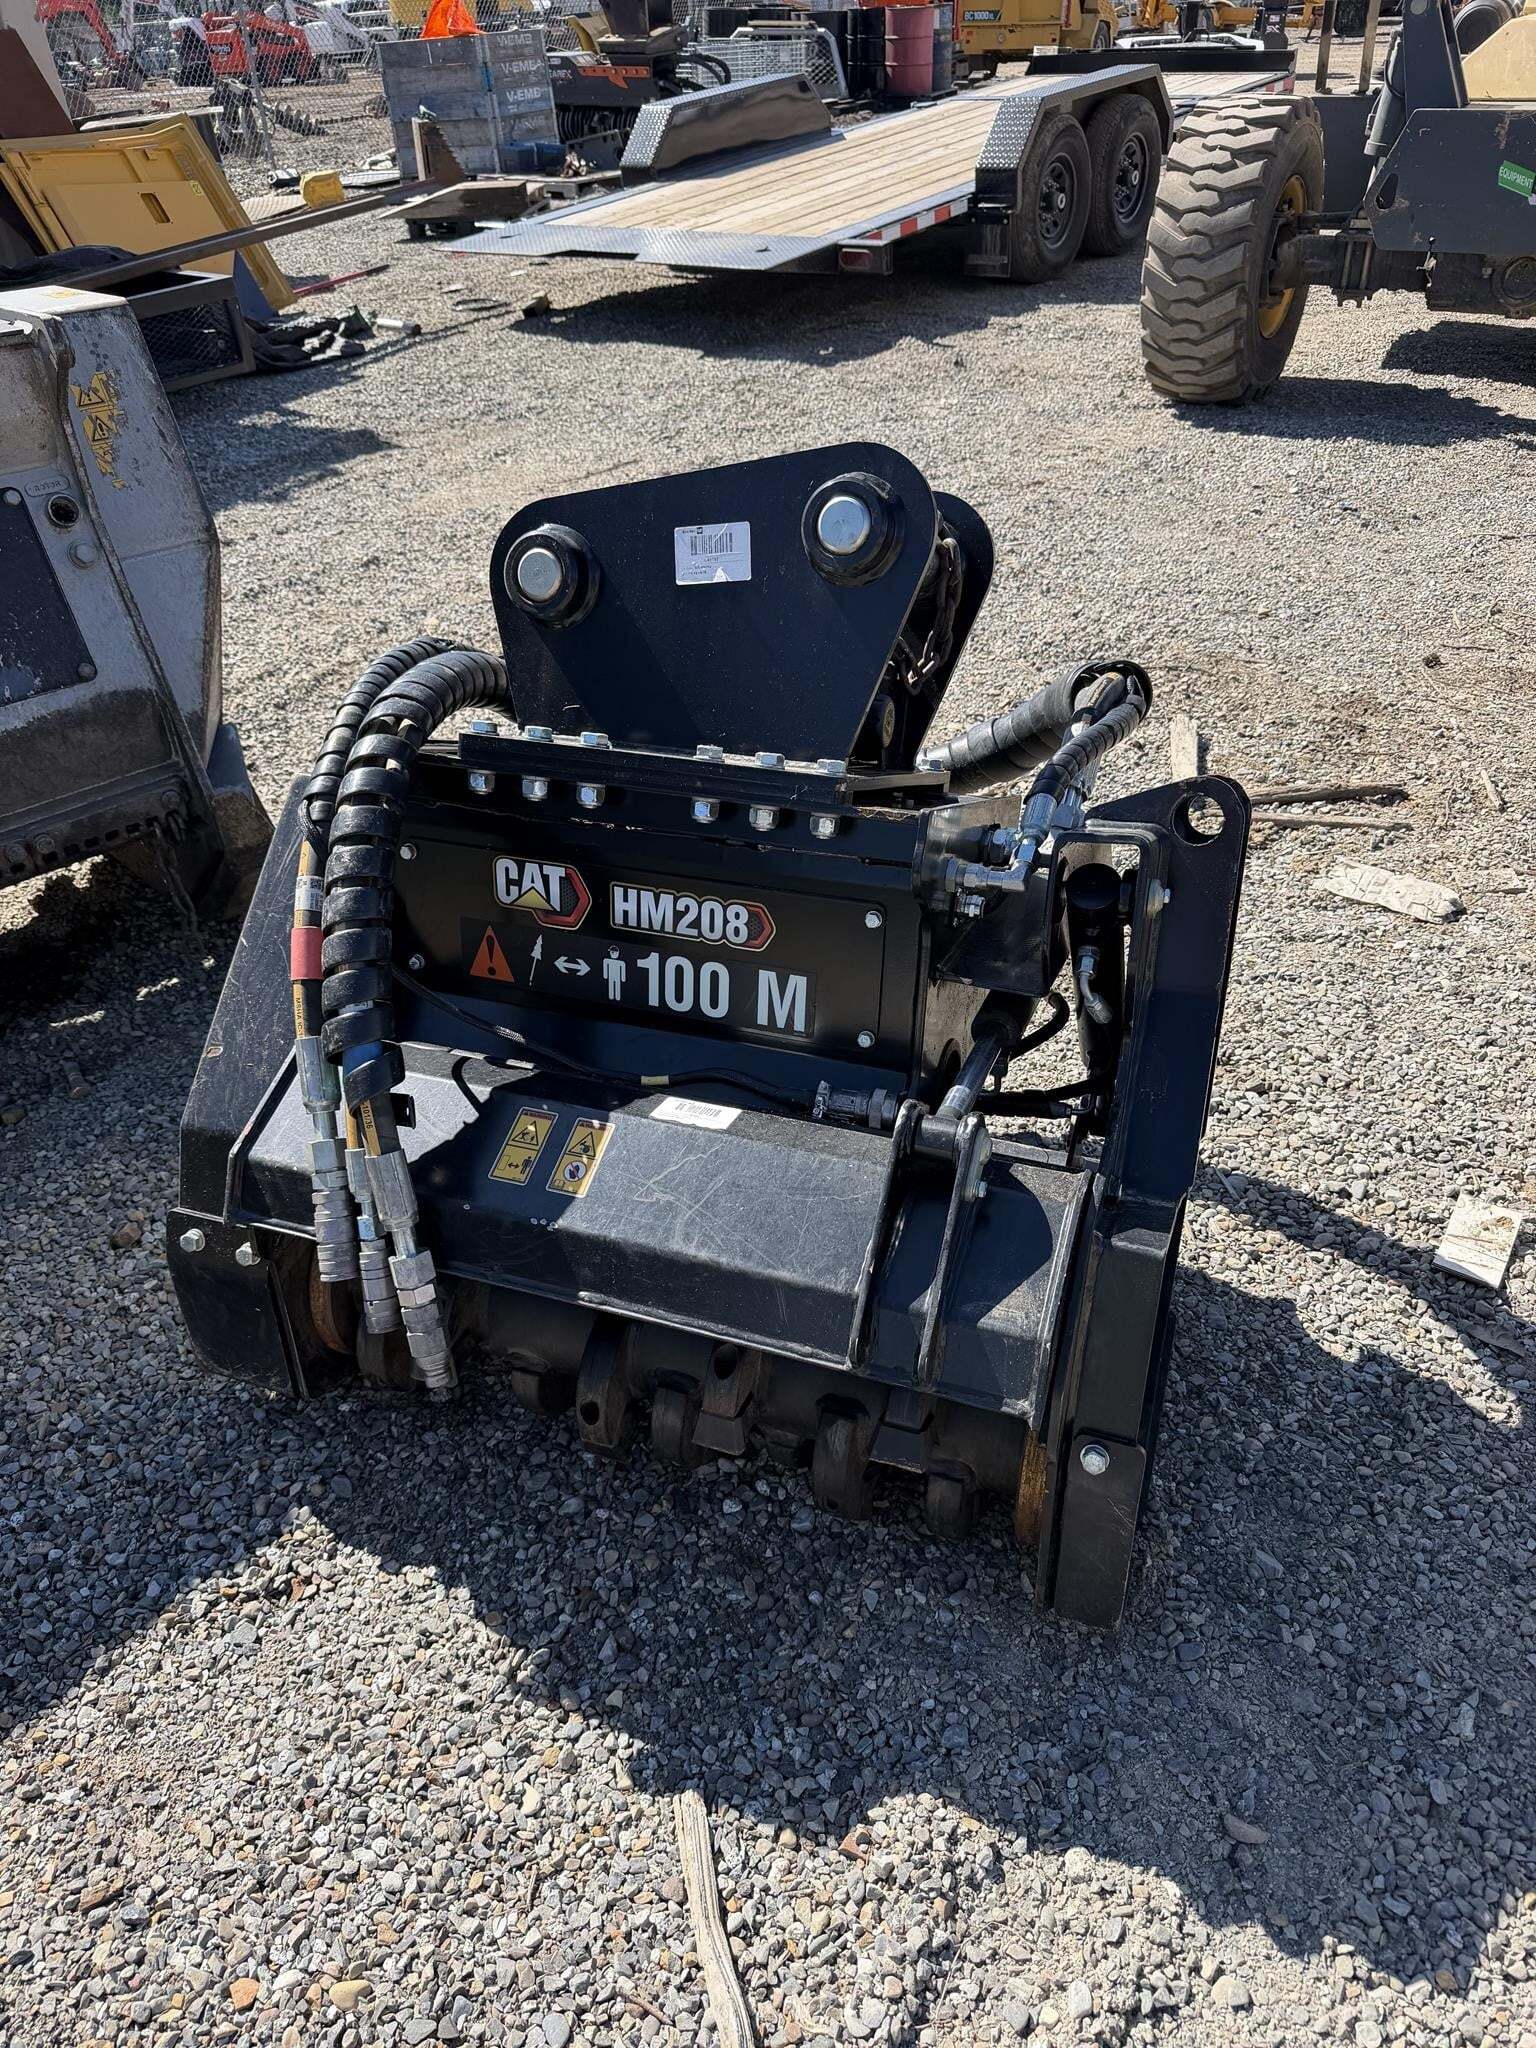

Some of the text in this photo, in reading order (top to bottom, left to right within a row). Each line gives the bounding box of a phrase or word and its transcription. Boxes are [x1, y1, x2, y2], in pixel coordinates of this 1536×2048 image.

[1499, 166, 1534, 189] EQUIPMENT
[495, 858, 566, 913] CAT
[613, 886, 749, 944] HM208
[637, 951, 807, 1032] 100 M
